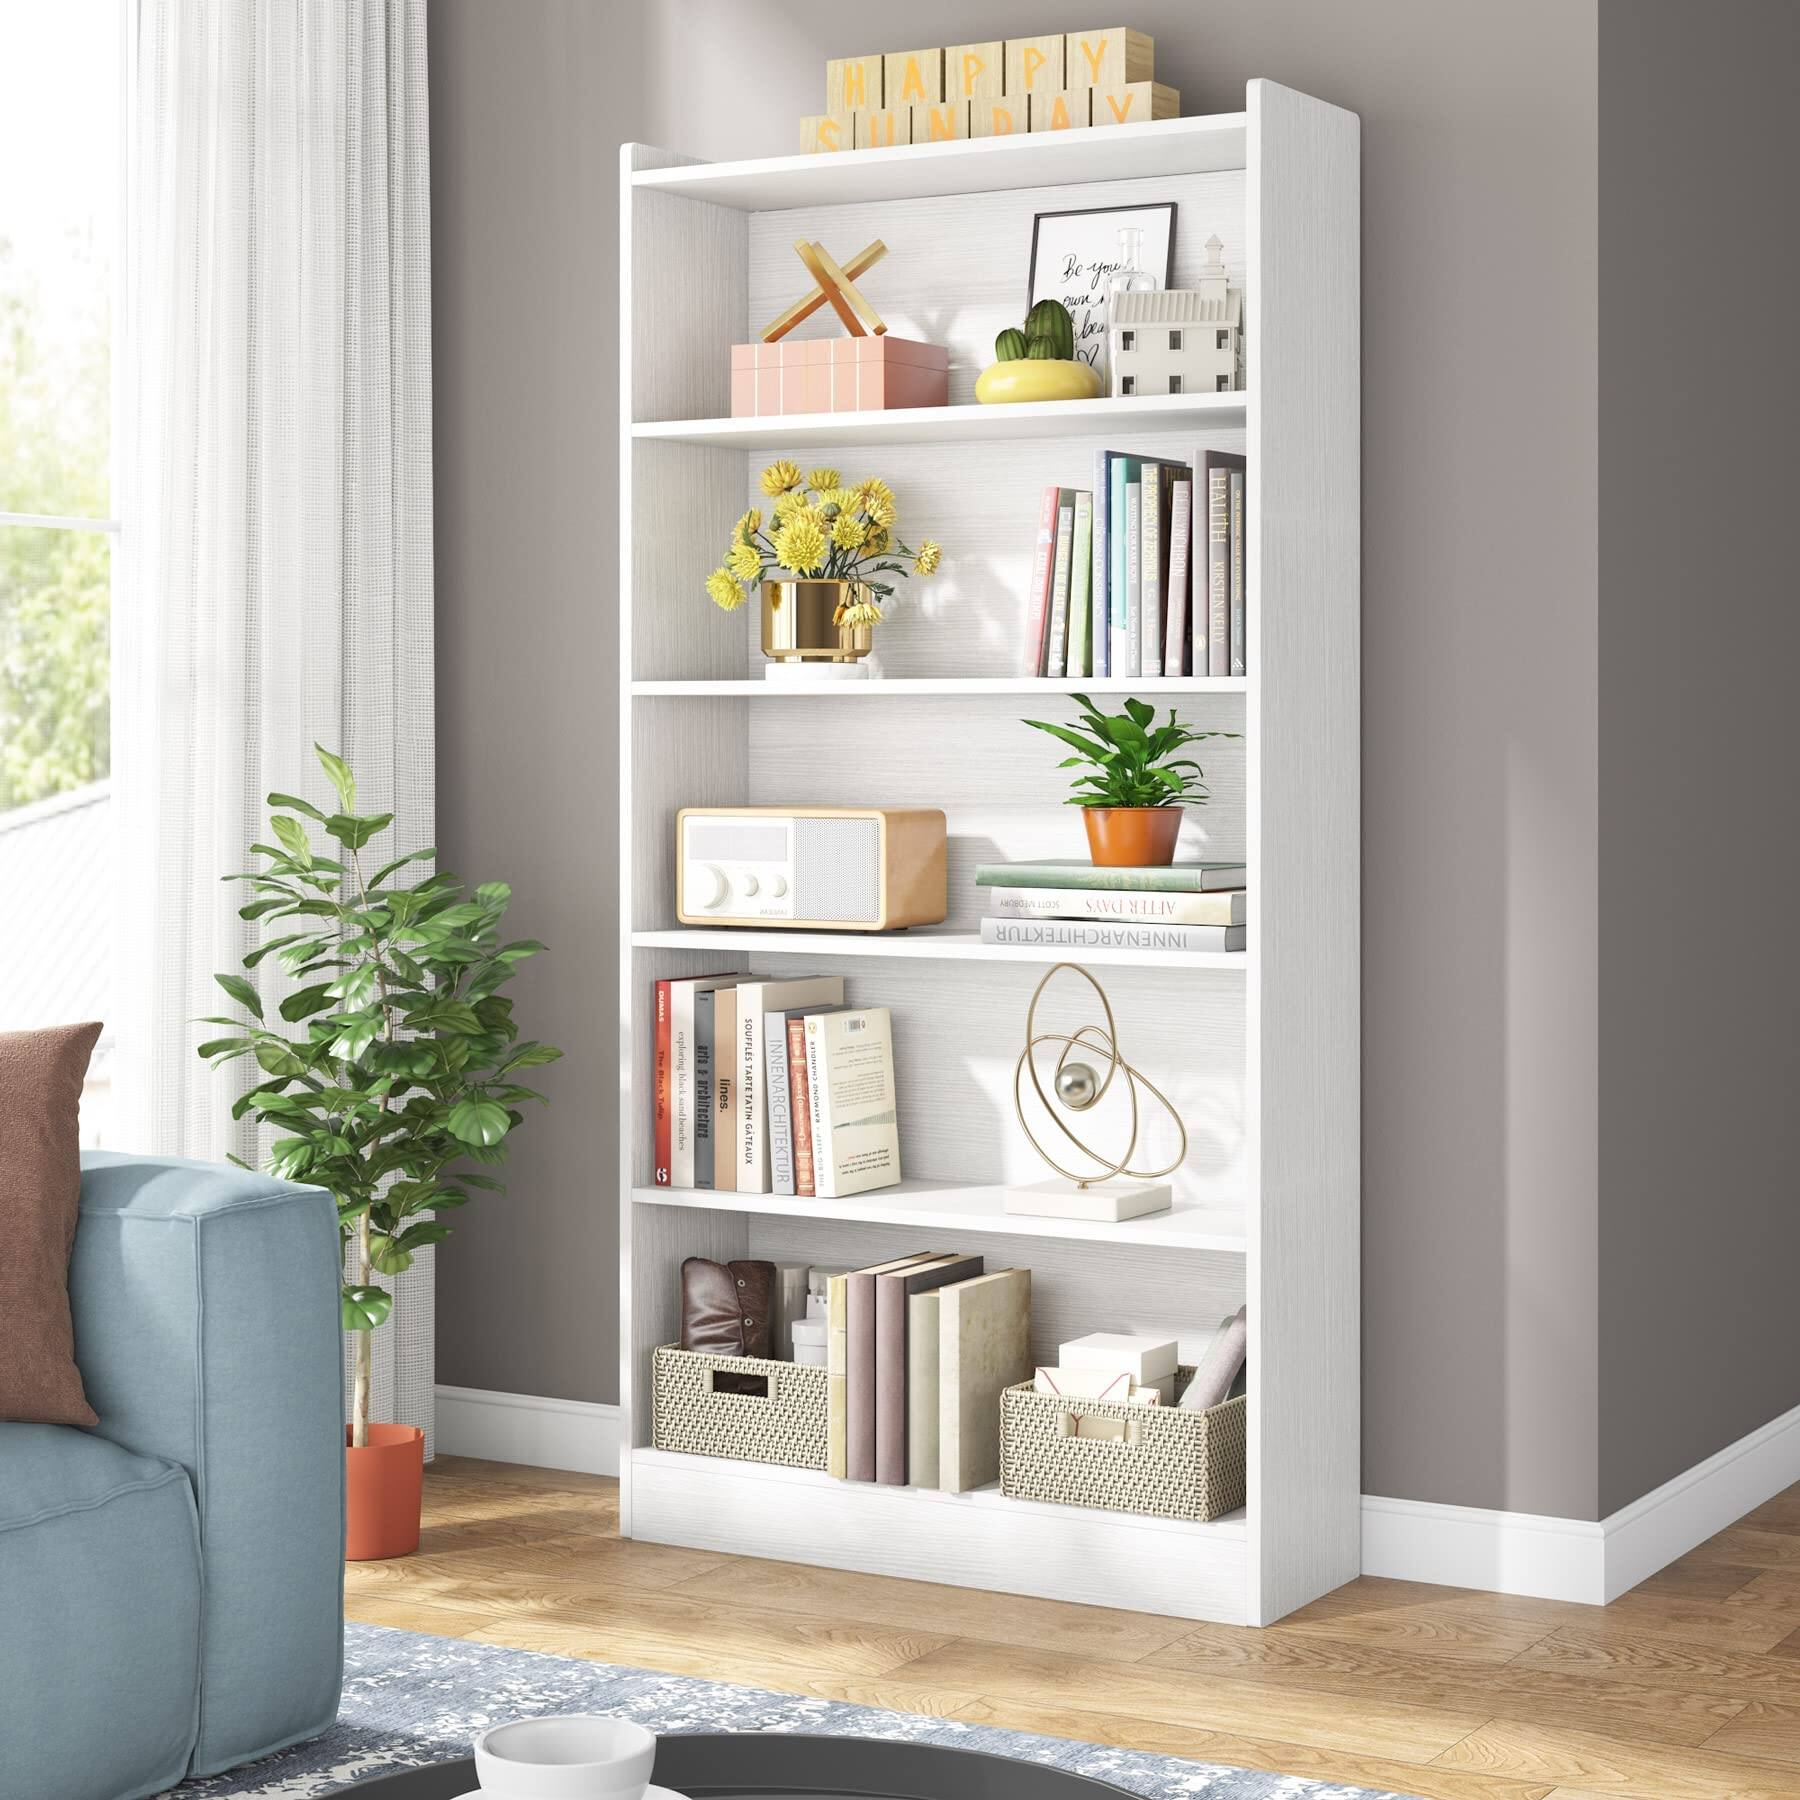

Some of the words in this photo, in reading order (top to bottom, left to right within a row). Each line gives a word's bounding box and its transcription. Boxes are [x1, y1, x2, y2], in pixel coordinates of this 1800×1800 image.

[844, 39, 1108, 109] HAPPY
[814, 93, 1134, 154] SUNDAY
[1060, 253, 1083, 283] Be
[1086, 262, 1123, 290] you
[1063, 293, 1091, 308] own
[1143, 468, 1157, 482] THE
[1143, 484, 1157, 525] PROPHECY
[1143, 528, 1157, 540] OF
[1212, 561, 1225, 610] KIRSTEN
[1212, 612, 1225, 644] KELLY
[1037, 901, 1060, 910] SCOTT
[1086, 898, 1124, 914] DAYS
[1129, 899, 1176, 916] AFTER
[996, 925, 1188, 948] INNENARCHITEKTUR
[676, 1031, 687, 1071] exploring
[697, 1045, 710, 1064] arts
[744, 1018, 755, 1062] SOUFFLÉS
[809, 1041, 818, 1082] CHANDLER
[678, 1073, 687, 1096] black
[744, 1065, 753, 1092] TARTE
[656, 1097, 665, 1120] Tulip
[678, 1097, 686, 1116] sand
[697, 1080, 711, 1138] architecture
[720, 1078, 731, 1113] lines.
[744, 1094, 753, 1120] TATIN
[769, 1039, 790, 1183] INNENARCHITEKTUR
[813, 1084, 821, 1123] RAYMOND
[678, 1117, 687, 1151] beaches
